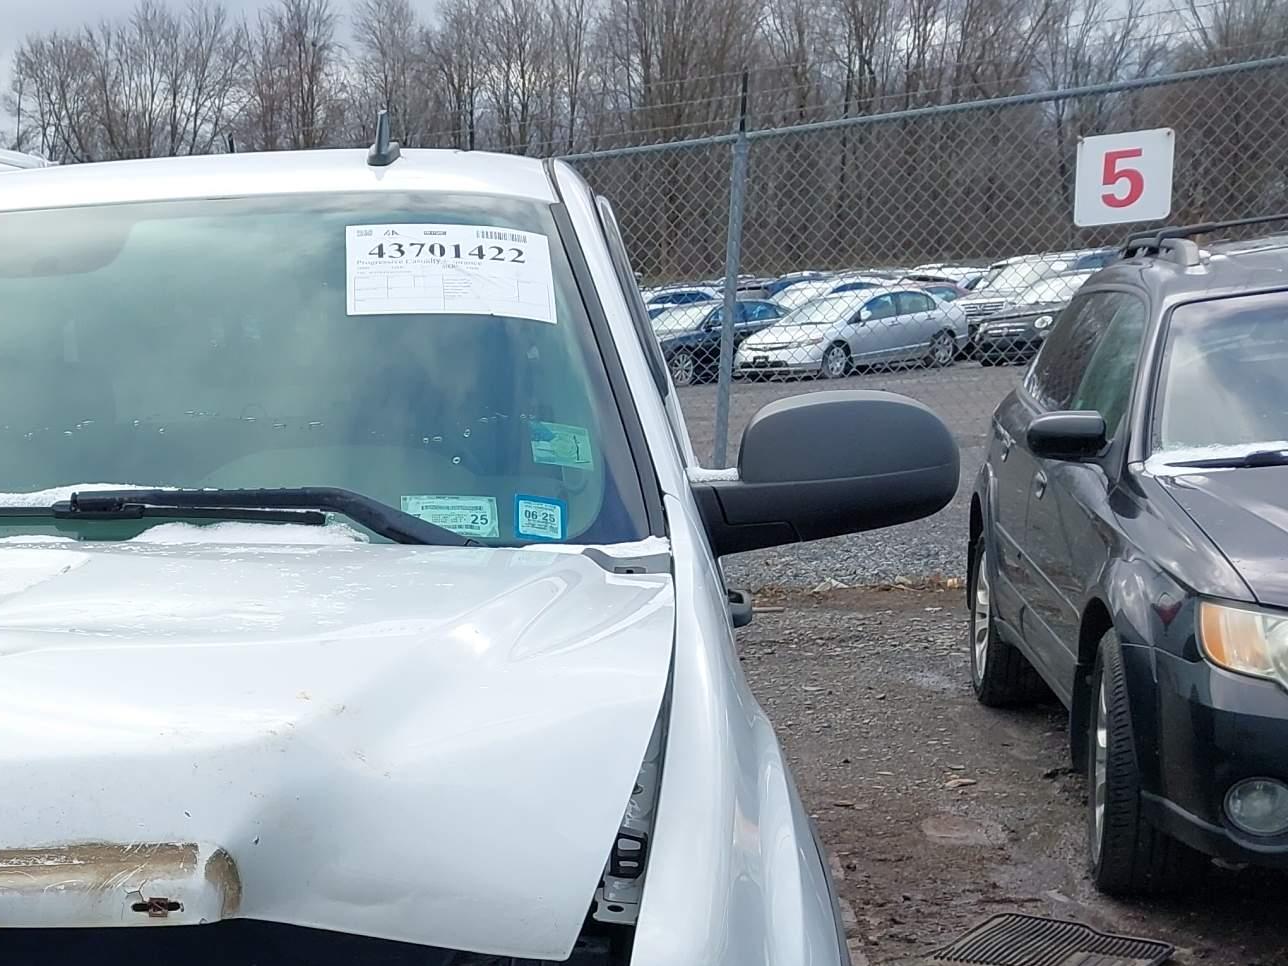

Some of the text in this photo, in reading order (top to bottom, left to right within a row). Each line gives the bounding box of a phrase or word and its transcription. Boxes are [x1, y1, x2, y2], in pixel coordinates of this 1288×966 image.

[1101, 148, 1144, 208] 5
[368, 242, 525, 263] 43701422
[470, 513, 489, 526] 25
[524, 509, 556, 523] 06 25
